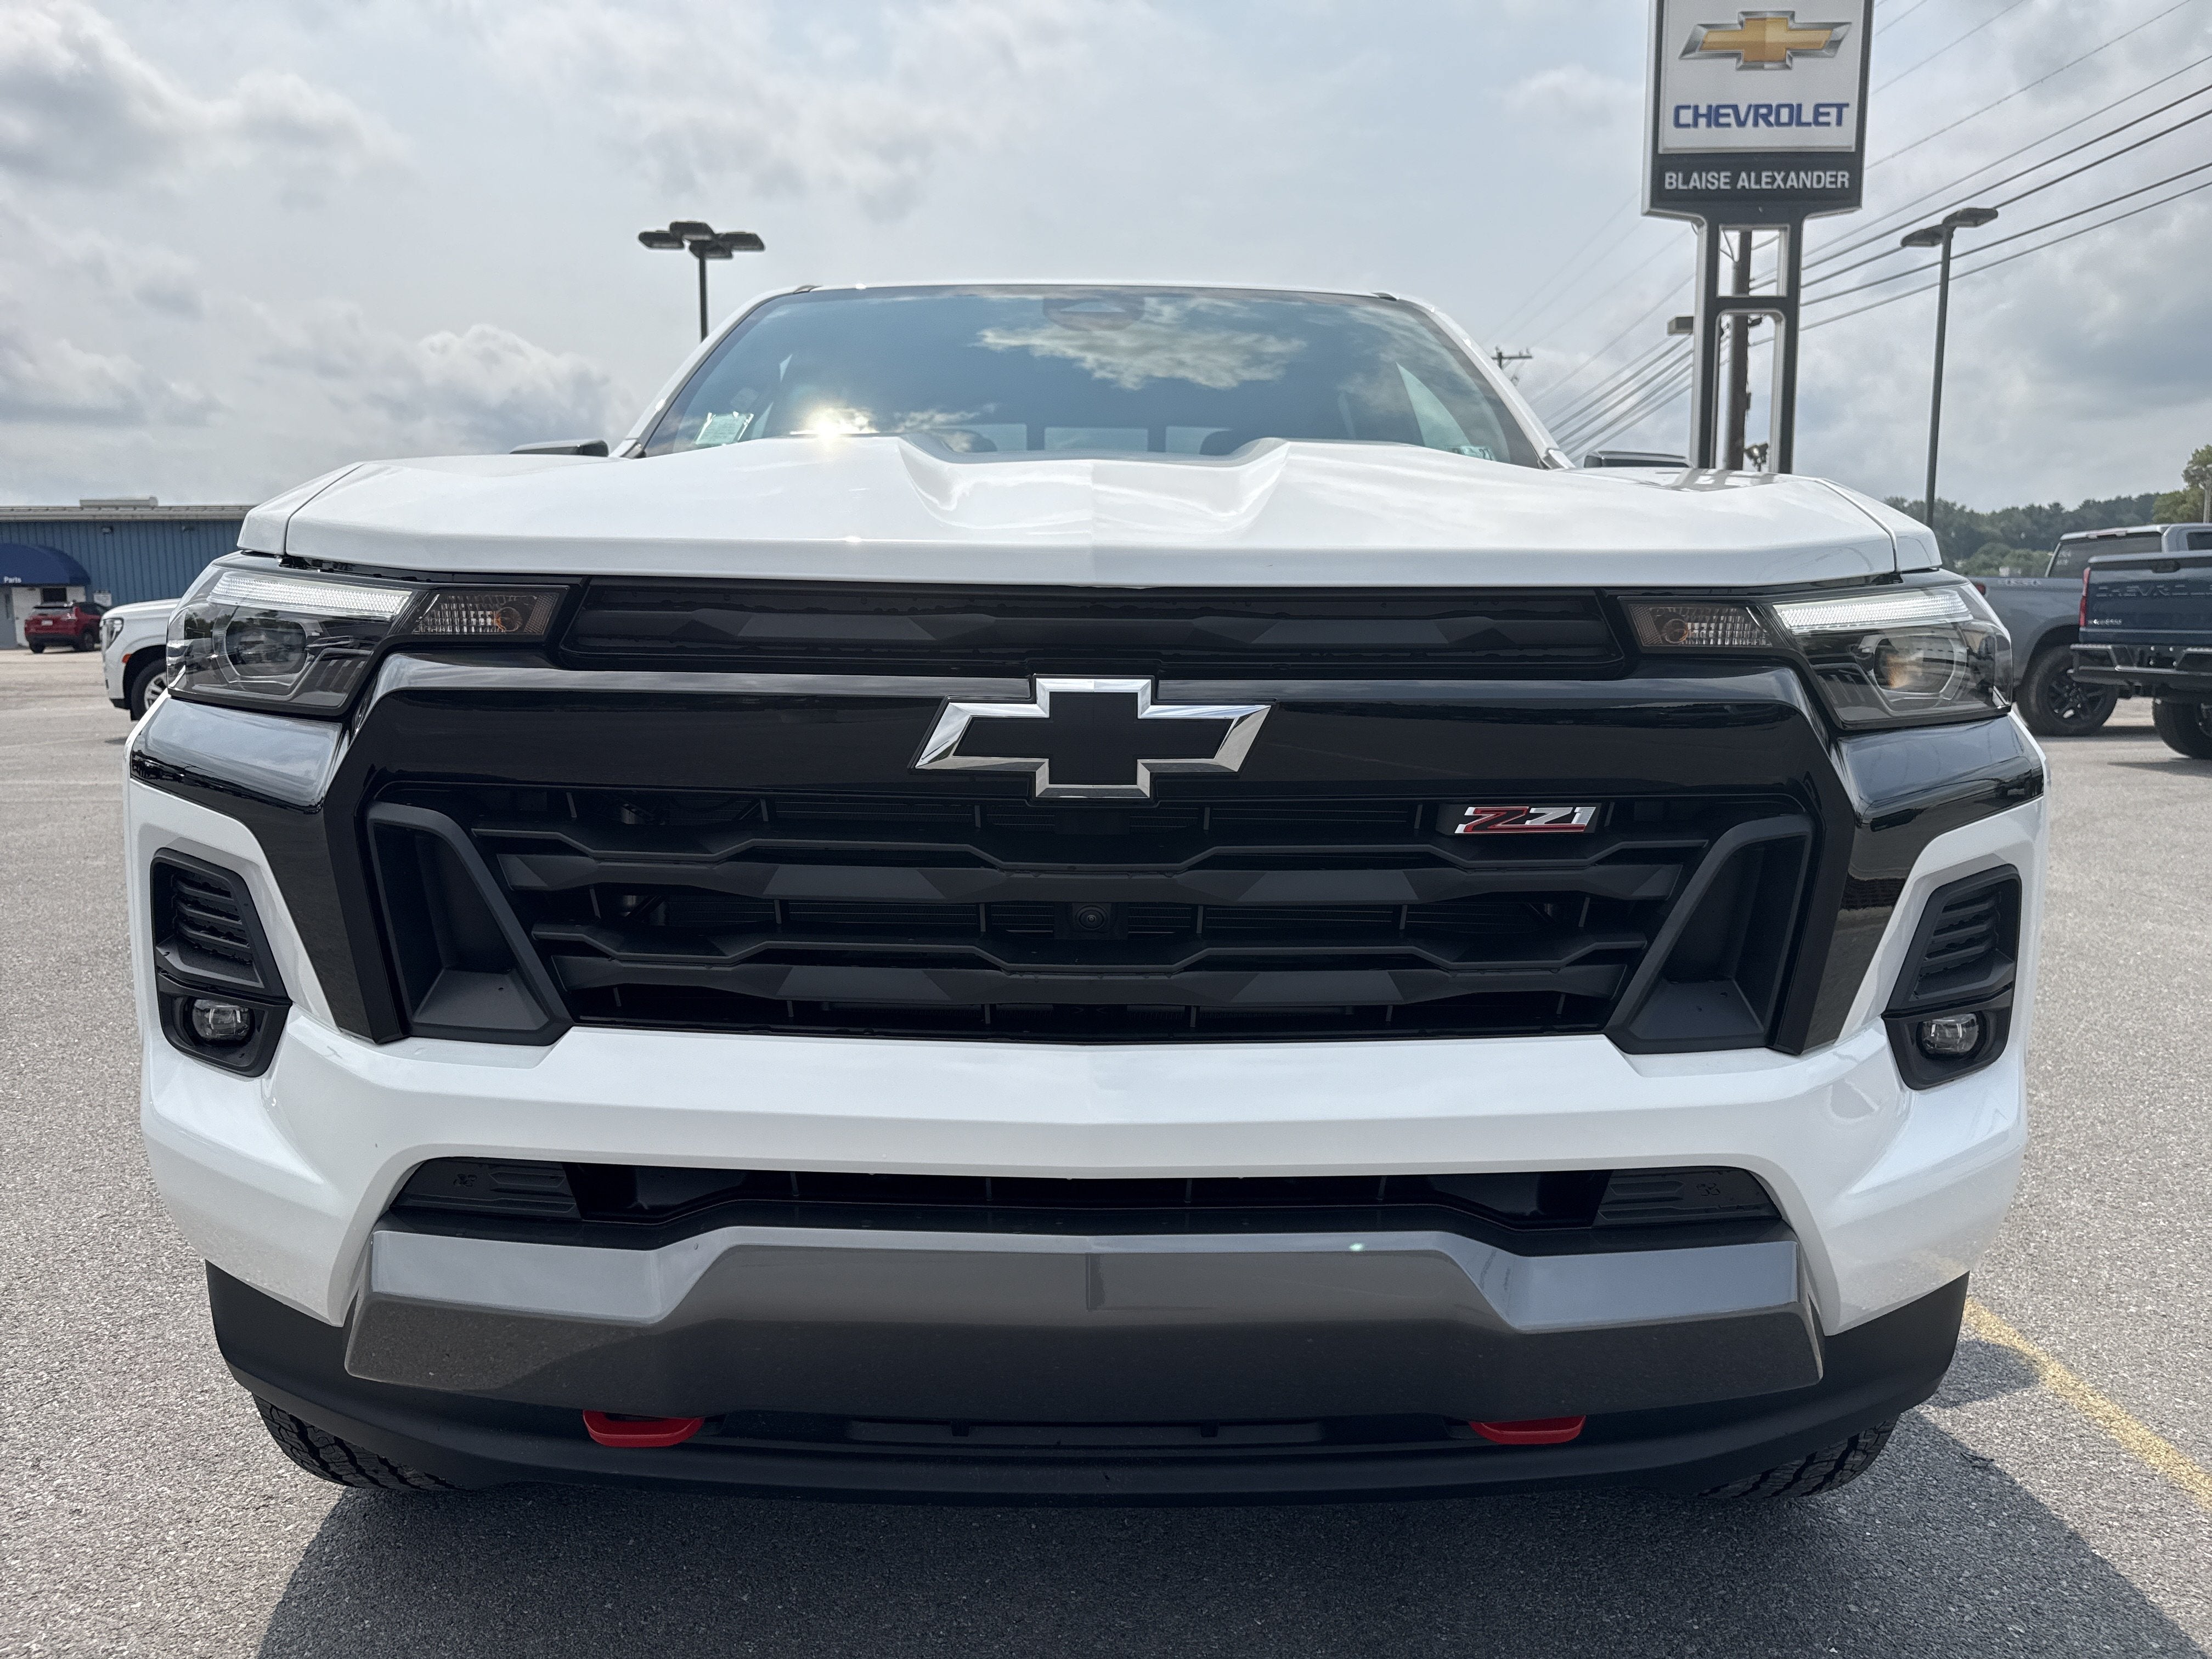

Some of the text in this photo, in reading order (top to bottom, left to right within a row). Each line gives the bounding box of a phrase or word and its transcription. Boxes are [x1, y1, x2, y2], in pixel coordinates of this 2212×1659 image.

[1673, 103, 1849, 128] CHEVROLET
[1664, 171, 1849, 190] BLAISE ALEXANDER
[1454, 806, 1596, 833] Z71
